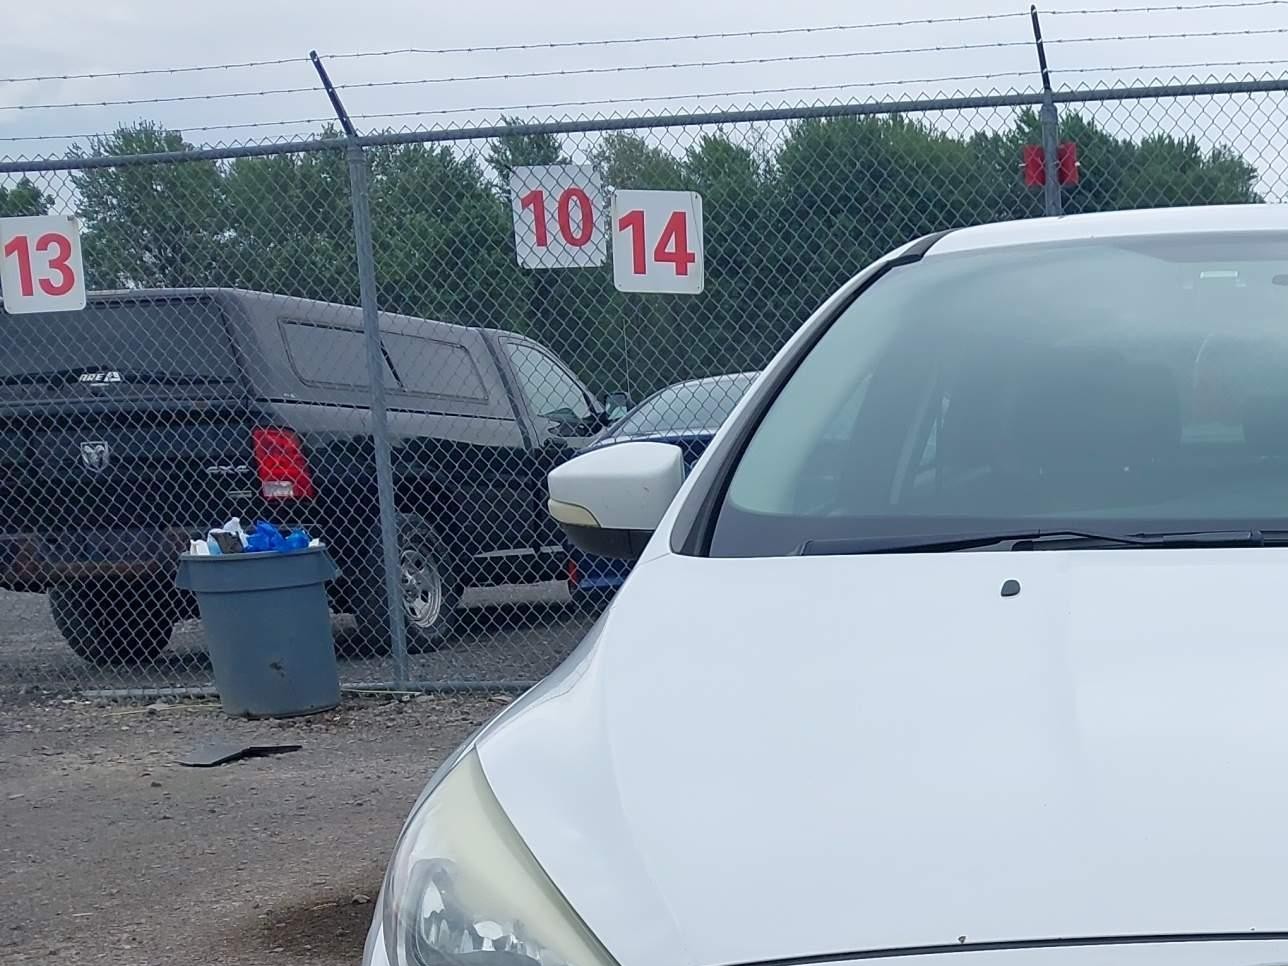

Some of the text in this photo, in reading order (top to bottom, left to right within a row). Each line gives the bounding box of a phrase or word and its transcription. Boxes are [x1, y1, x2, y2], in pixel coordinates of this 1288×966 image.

[520, 187, 594, 248] 10
[618, 210, 696, 276] 14
[4, 232, 75, 296] 13
